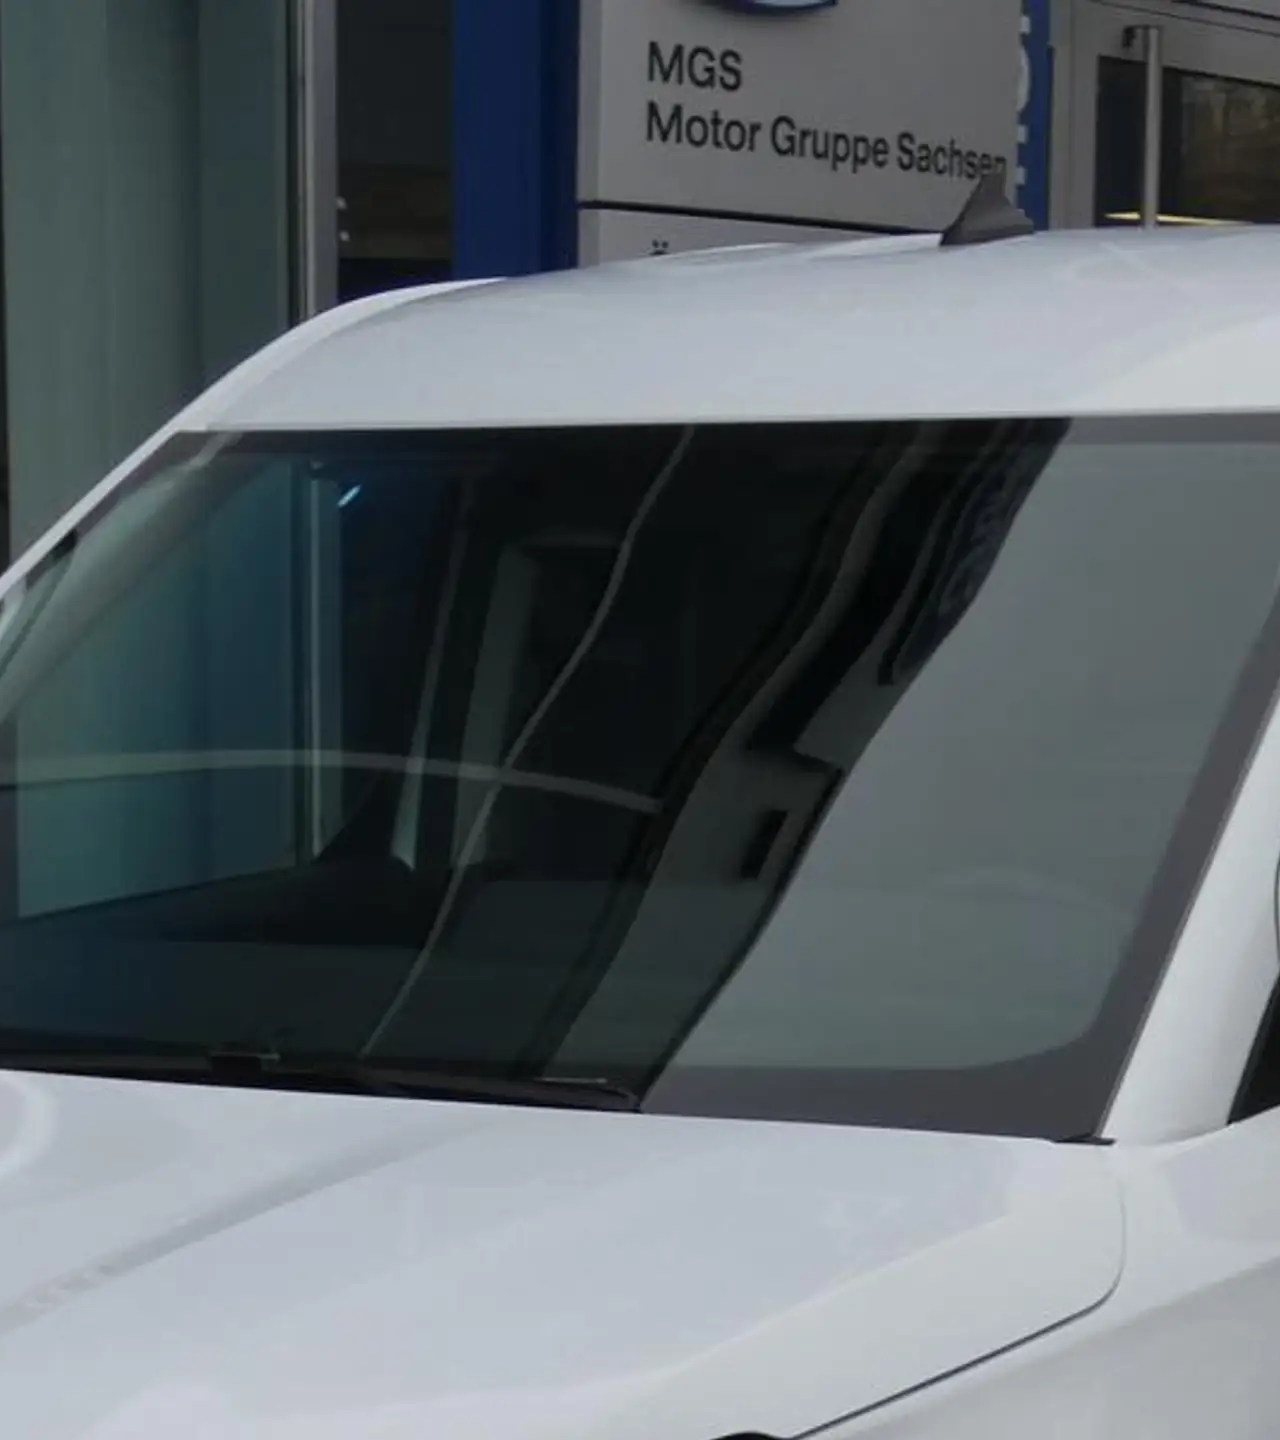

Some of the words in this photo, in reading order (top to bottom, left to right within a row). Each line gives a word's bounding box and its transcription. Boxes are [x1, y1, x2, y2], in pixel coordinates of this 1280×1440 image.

[647, 40, 743, 92] MGS
[645, 100, 763, 153] Motor
[770, 114, 890, 175] Gruppe
